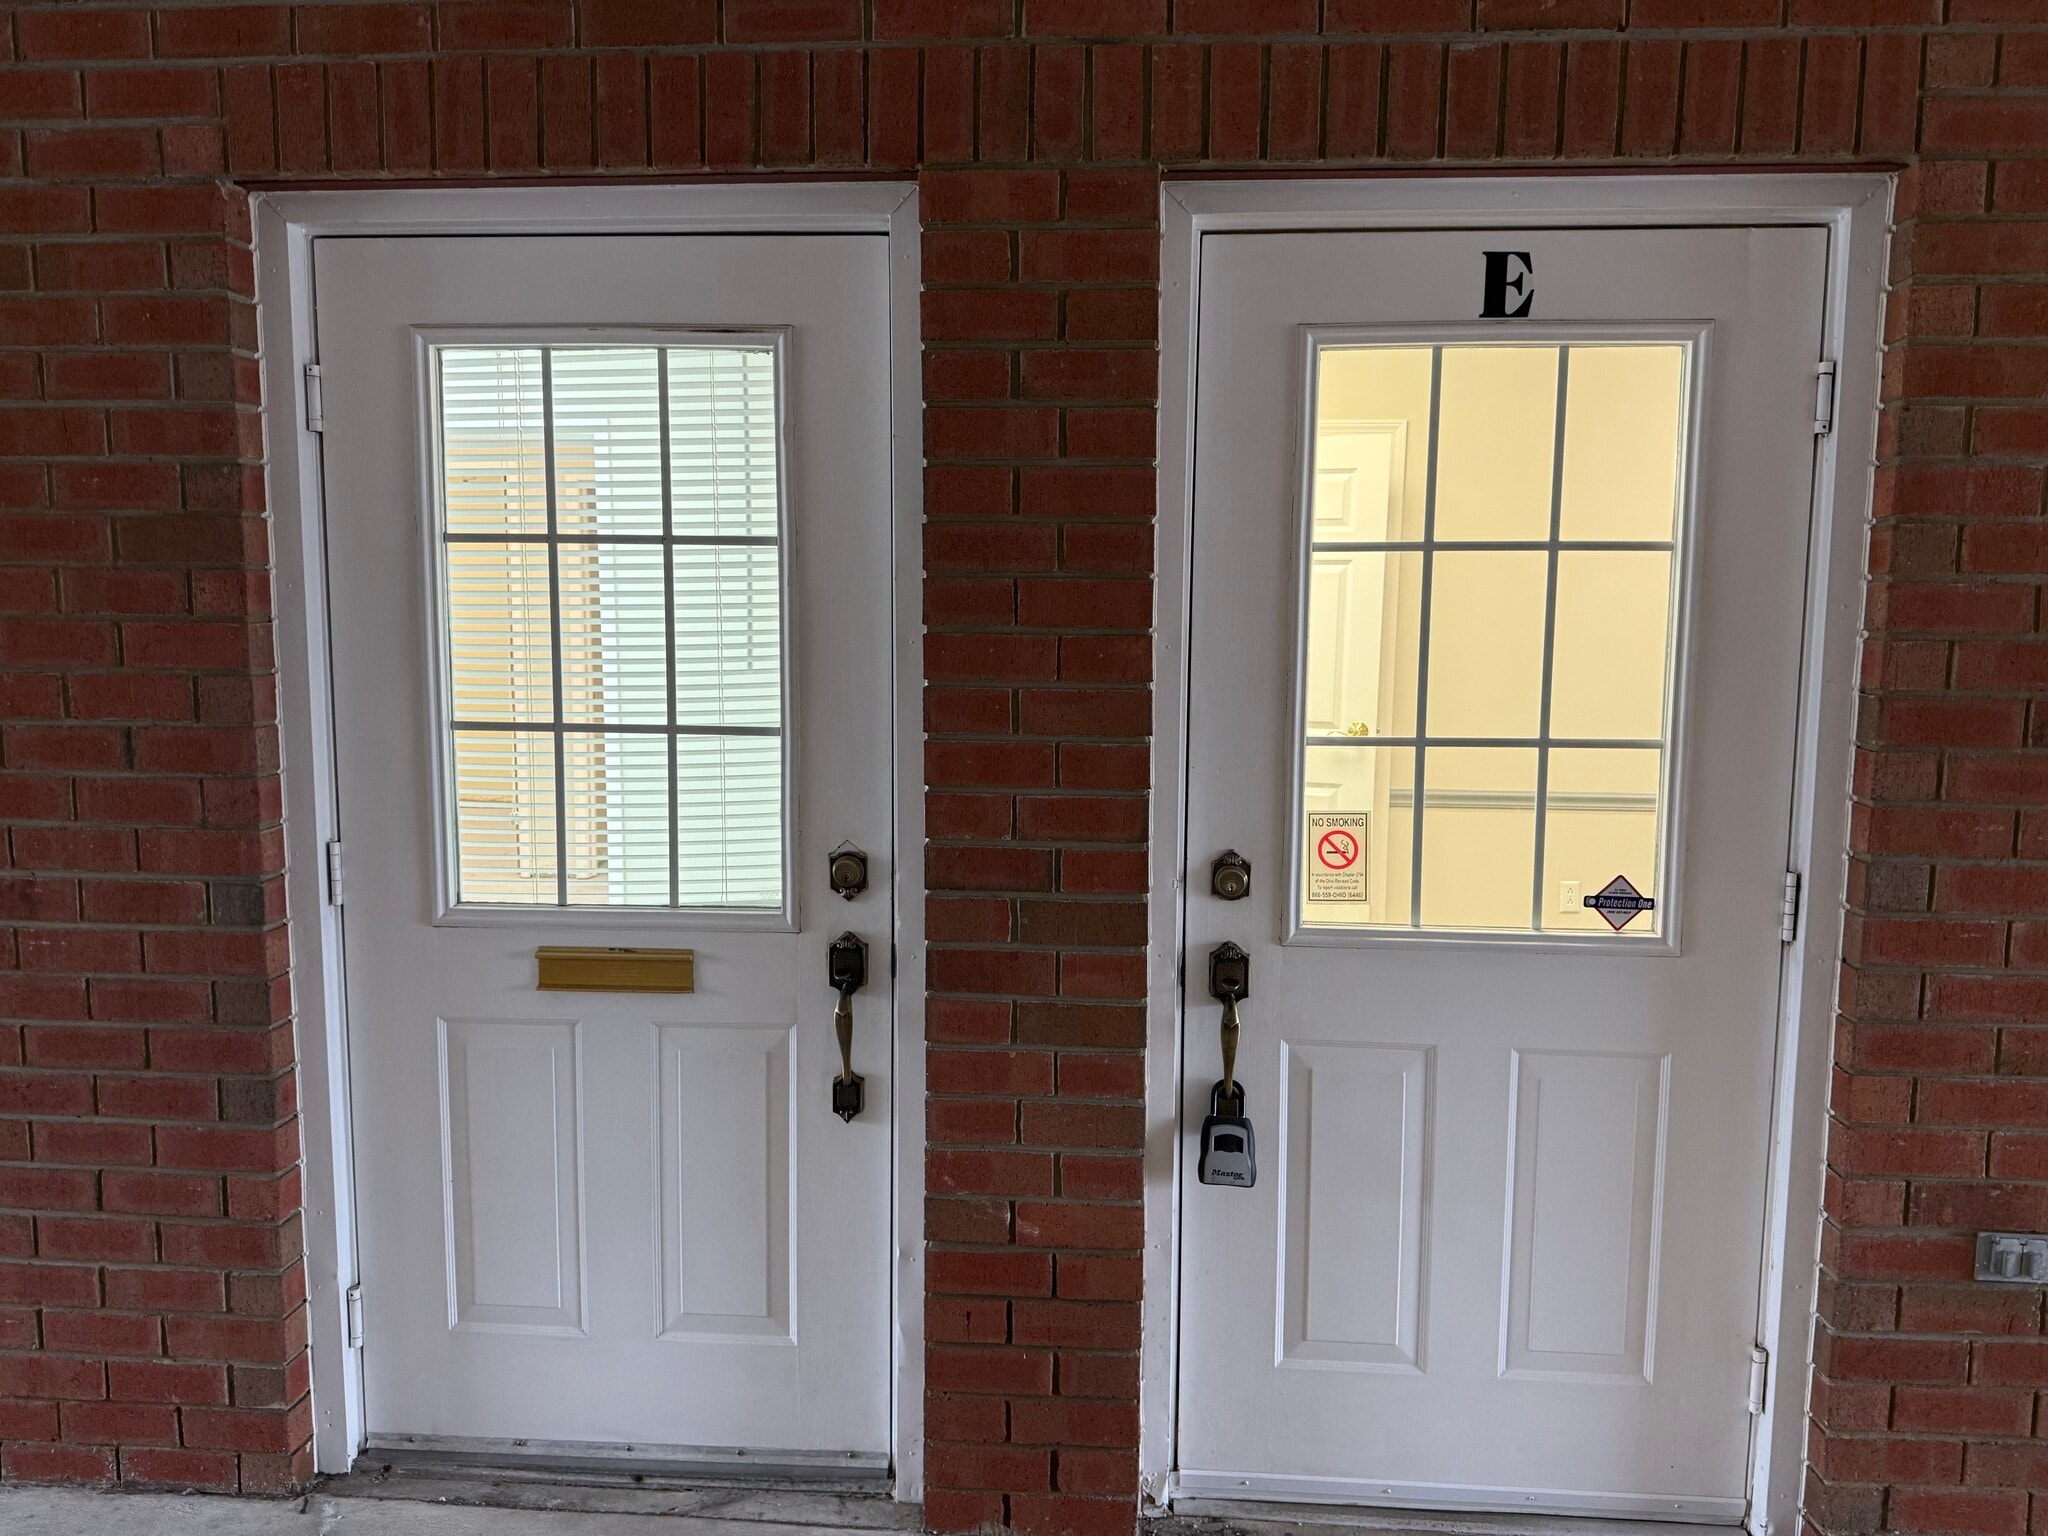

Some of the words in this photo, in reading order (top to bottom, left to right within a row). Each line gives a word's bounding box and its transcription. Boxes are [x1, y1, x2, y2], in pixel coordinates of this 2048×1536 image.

[1479, 251, 1535, 318] E
[1312, 817, 1324, 827] NO
[1326, 817, 1364, 828] SMOKING
[1598, 897, 1637, 908] Protection
[1637, 899, 1653, 909] One
[1212, 1169, 1243, 1177] Master
